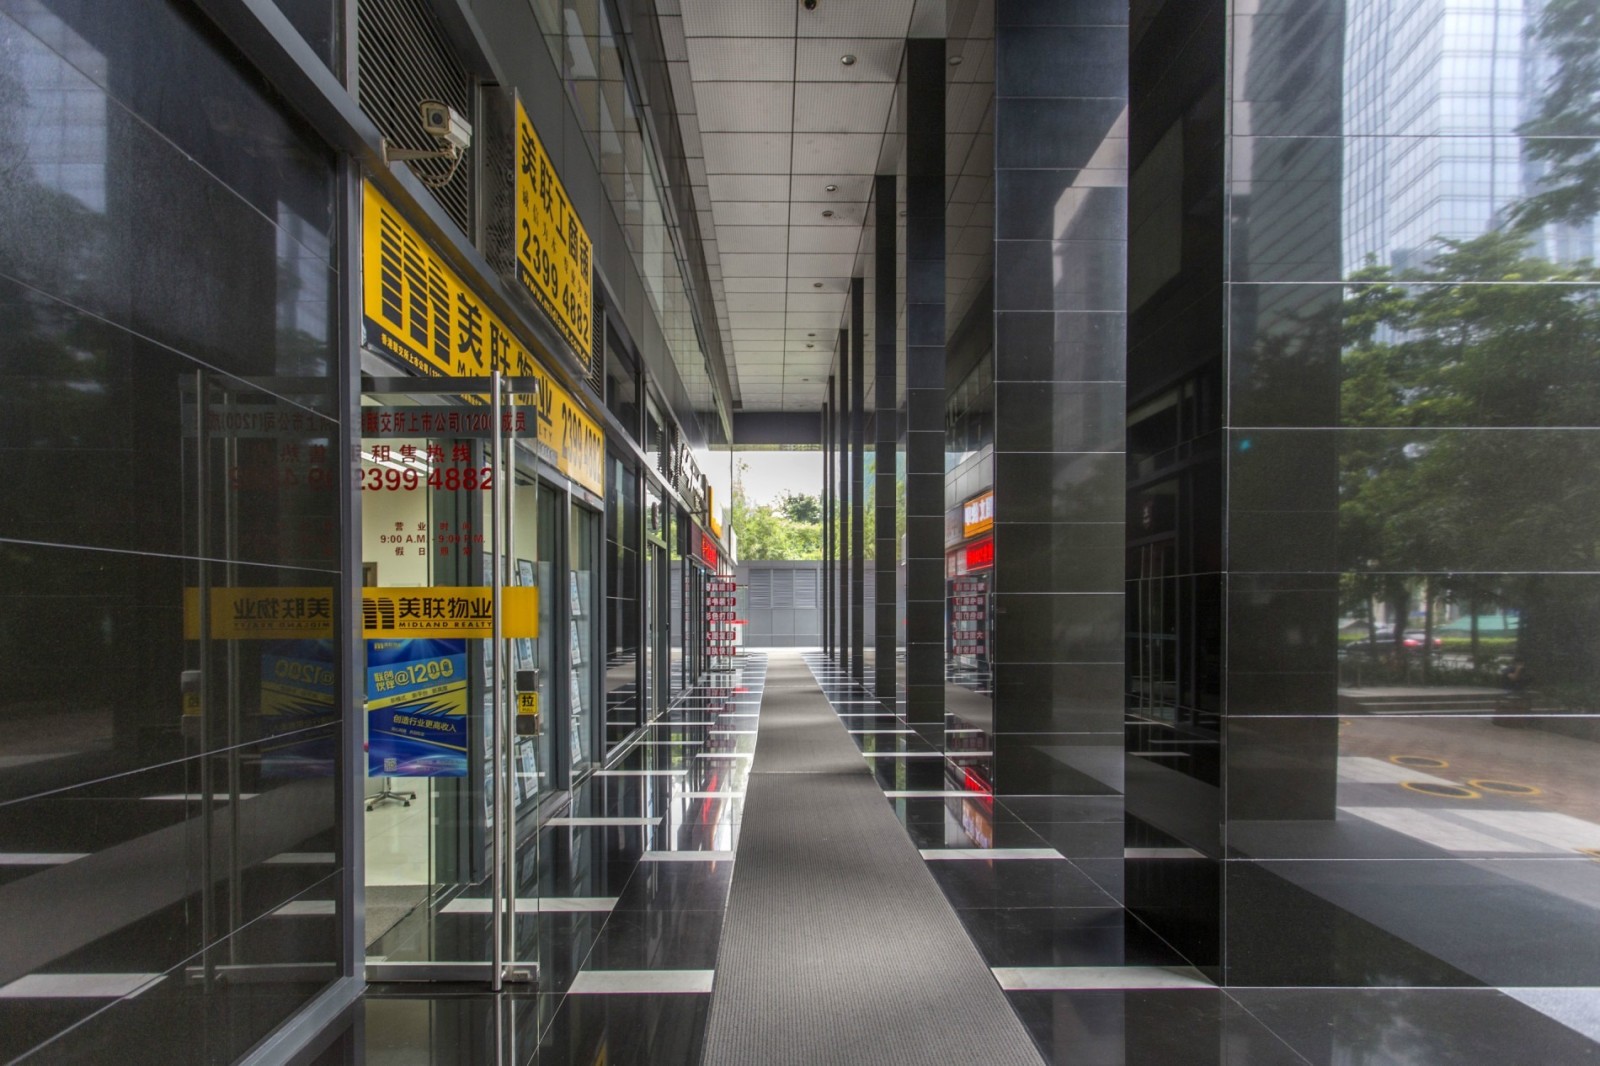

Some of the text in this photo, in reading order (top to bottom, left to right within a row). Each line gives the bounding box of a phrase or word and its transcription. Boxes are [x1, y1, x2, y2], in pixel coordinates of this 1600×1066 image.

[522, 218, 589, 345] 2399 4882
[371, 443, 472, 464] 租售热线
[427, 467, 492, 491] 4882
[380, 534, 402, 544] 9:00
[438, 534, 460, 544] 9:00
[398, 596, 492, 619] 美联物业
[521, 695, 534, 707] 拉
